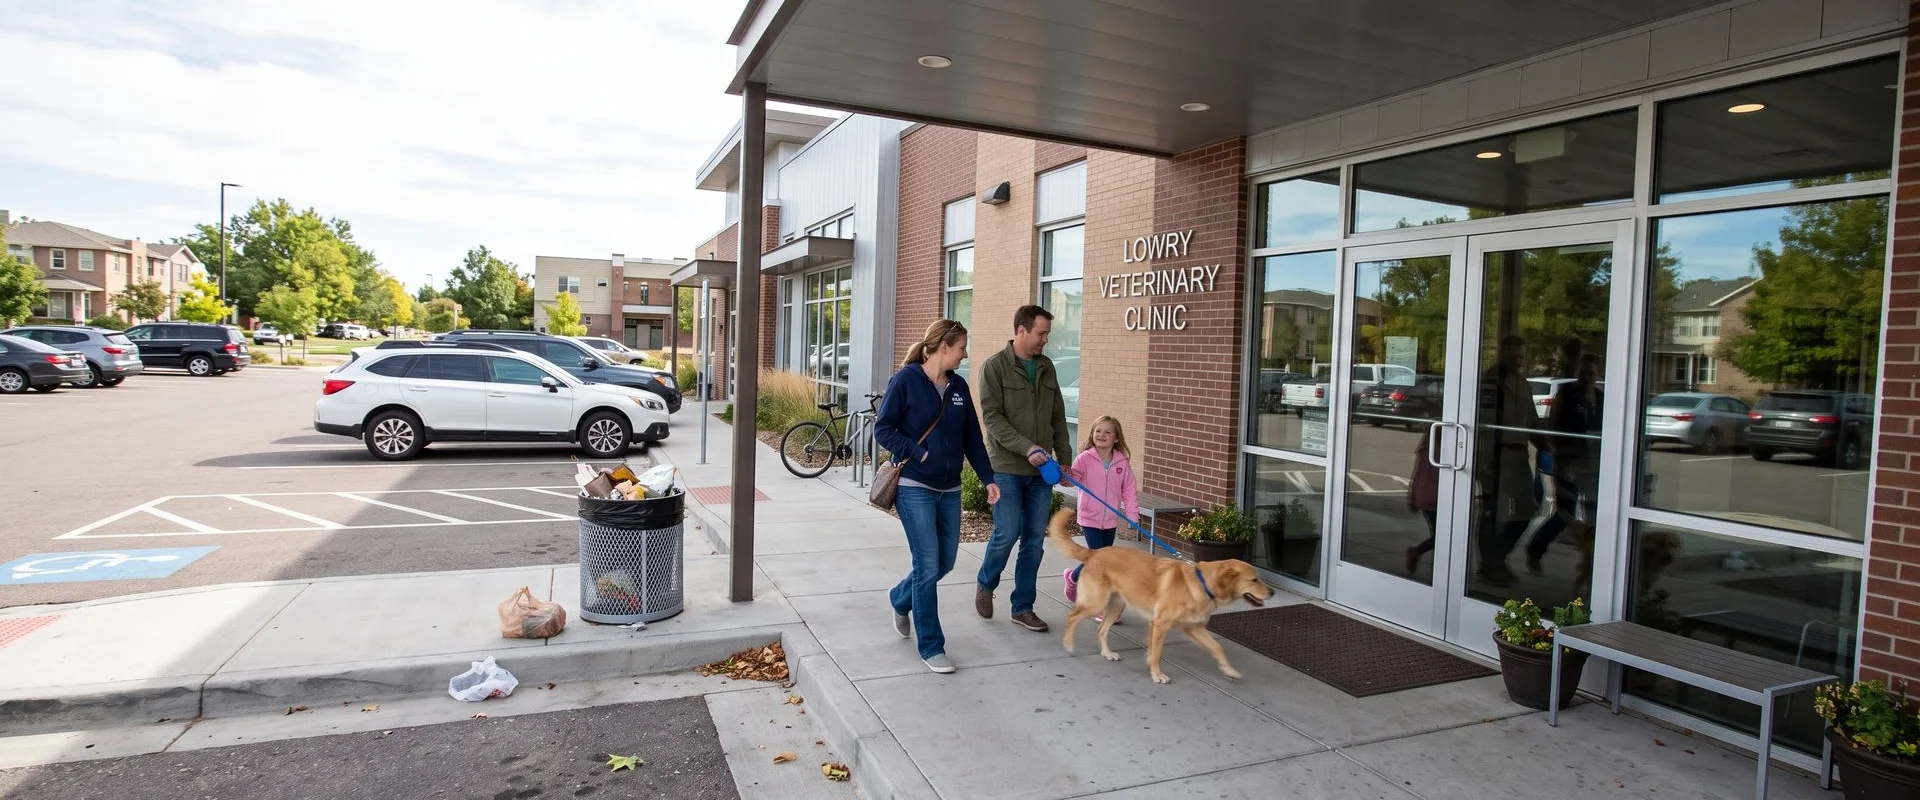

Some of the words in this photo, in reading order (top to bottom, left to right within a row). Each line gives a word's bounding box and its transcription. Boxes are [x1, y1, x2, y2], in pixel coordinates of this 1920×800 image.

[1123, 229, 1193, 263] LOWRY
[1098, 264, 1220, 299] VETERINARY
[1124, 304, 1187, 331] CLINIC
